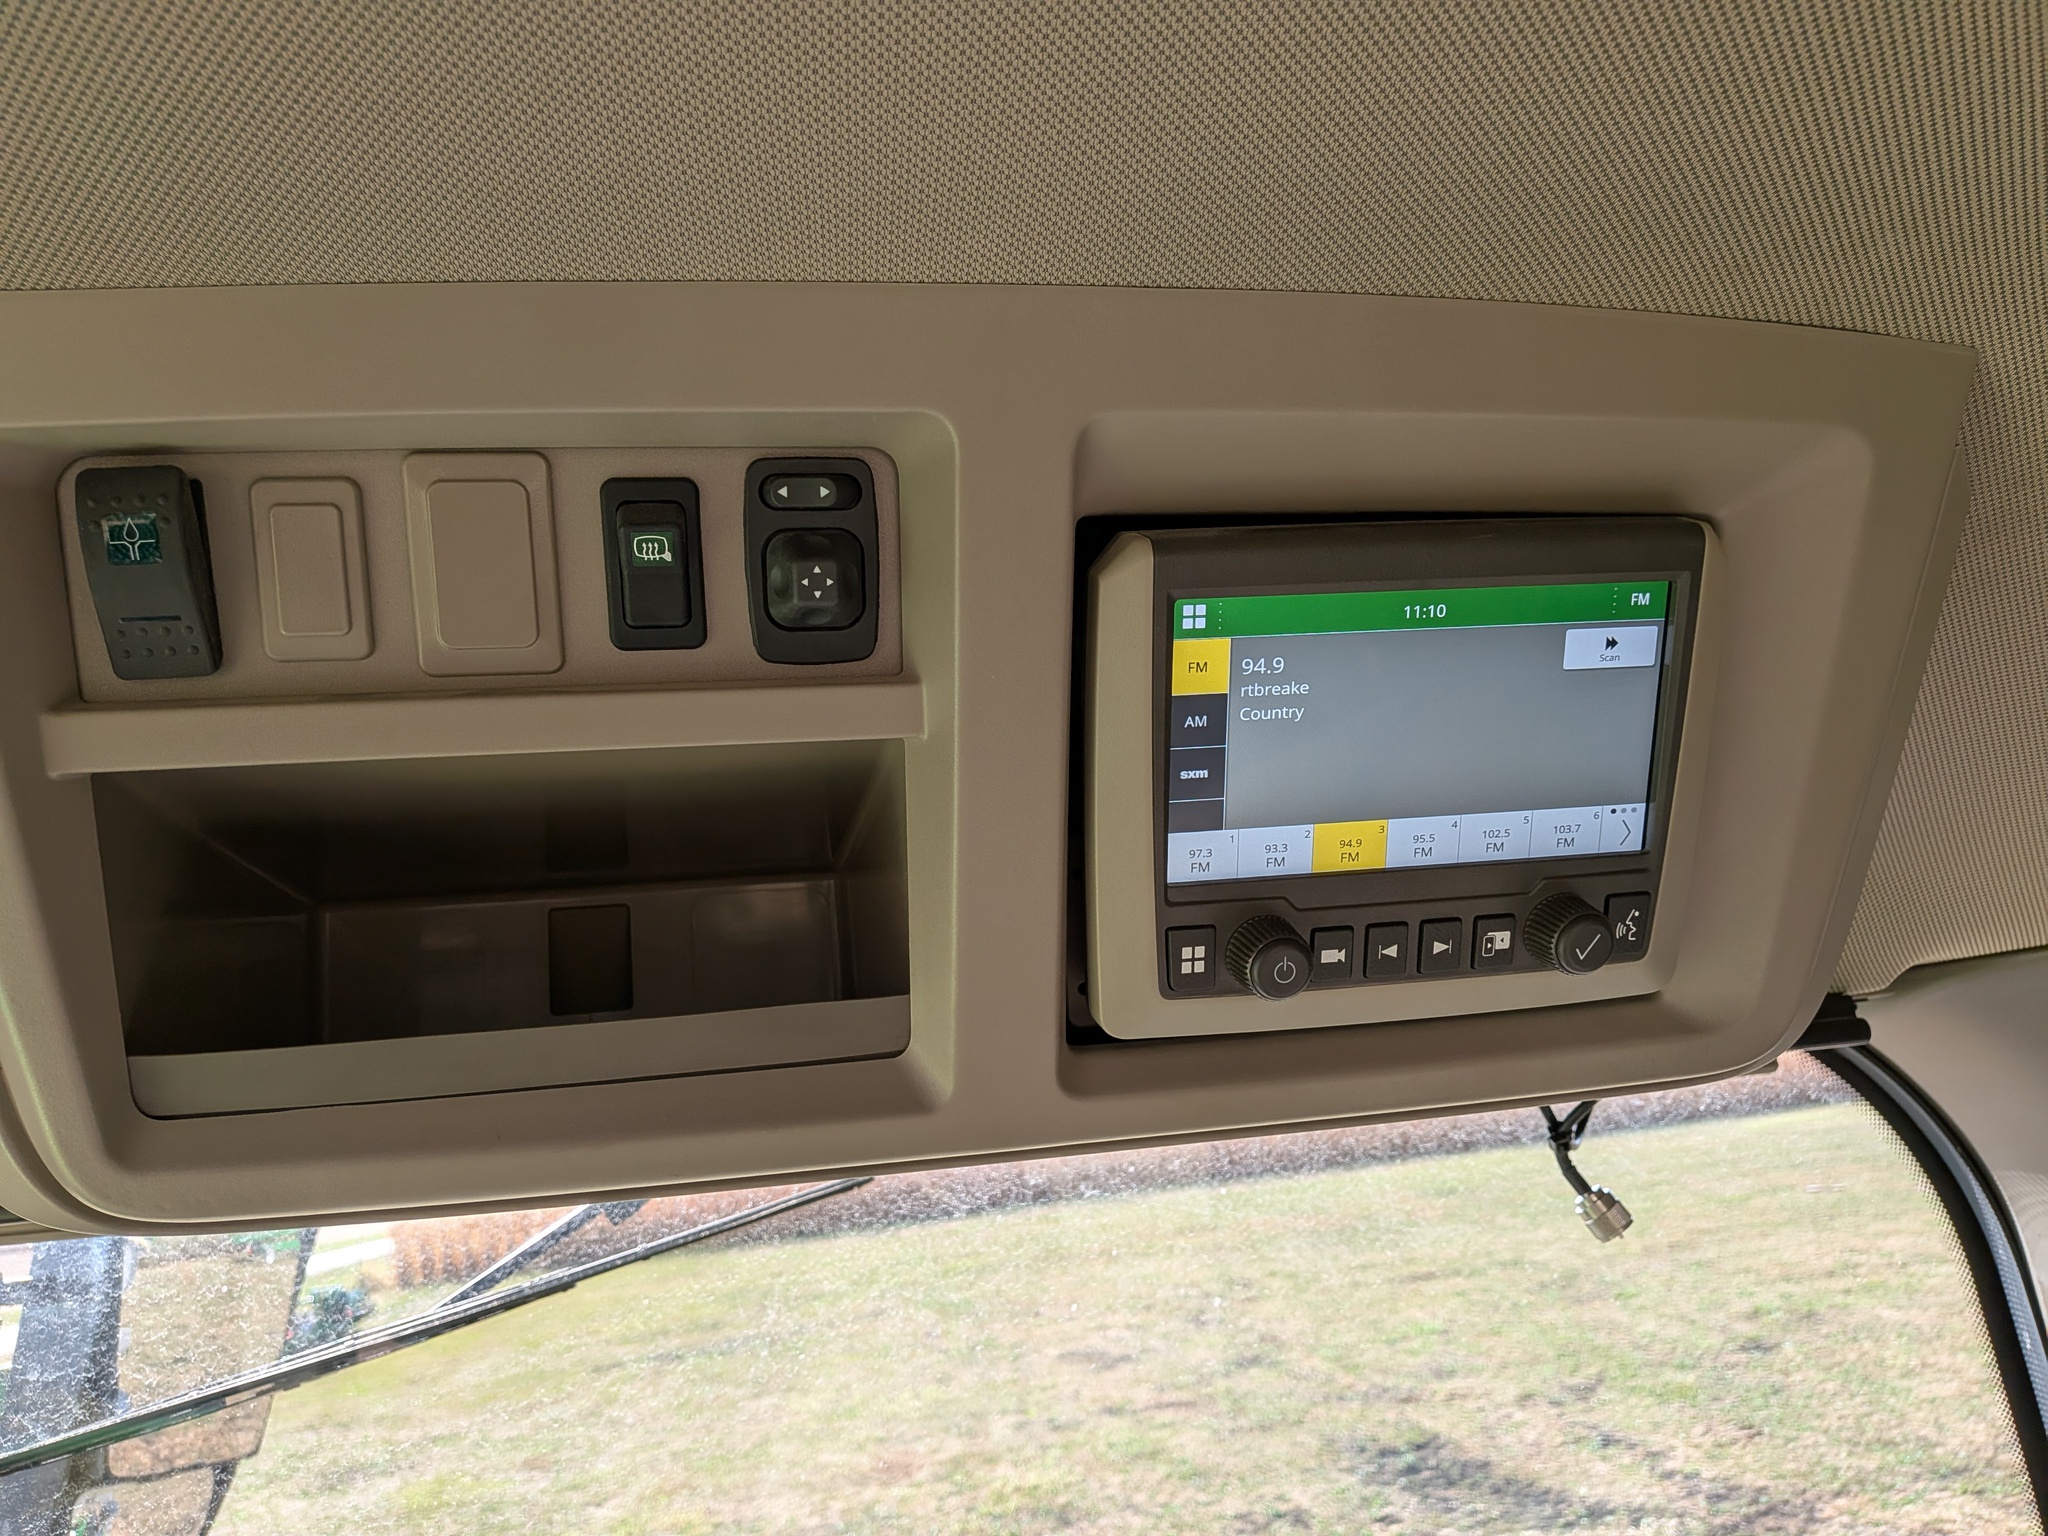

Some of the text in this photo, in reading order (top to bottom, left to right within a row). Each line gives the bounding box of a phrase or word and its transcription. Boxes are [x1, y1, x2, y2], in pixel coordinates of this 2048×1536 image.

[1630, 592, 1650, 606] FM
[1403, 603, 1447, 619] 11:10
[1599, 653, 1621, 662] Scan
[1188, 661, 1208, 674] FM
[1241, 657, 1285, 675] 94.9
[1240, 681, 1310, 697] rtbreake
[1239, 706, 1305, 722] Country
[1184, 715, 1208, 728] AM
[1179, 768, 1209, 780] sxm
[1523, 815, 1530, 825] 5
[1593, 811, 1600, 821] 6
[1378, 825, 1385, 835] 3
[1451, 820, 1458, 830] 4
[1553, 823, 1582, 835] 103.7
[1229, 834, 1235, 844] 1
[1304, 830, 1311, 839] 2
[1412, 833, 1436, 844] 95.5
[1482, 828, 1511, 839] 102.5
[1339, 838, 1363, 849] 94.9
[1485, 842, 1505, 853] FM
[1556, 837, 1575, 848] FM
[1188, 848, 1213, 859] 97.3
[1264, 843, 1289, 854] 93.3
[1413, 847, 1433, 858] FM
[1266, 857, 1286, 868] FM
[1340, 852, 1360, 863] FM
[1190, 861, 1210, 873] FM
